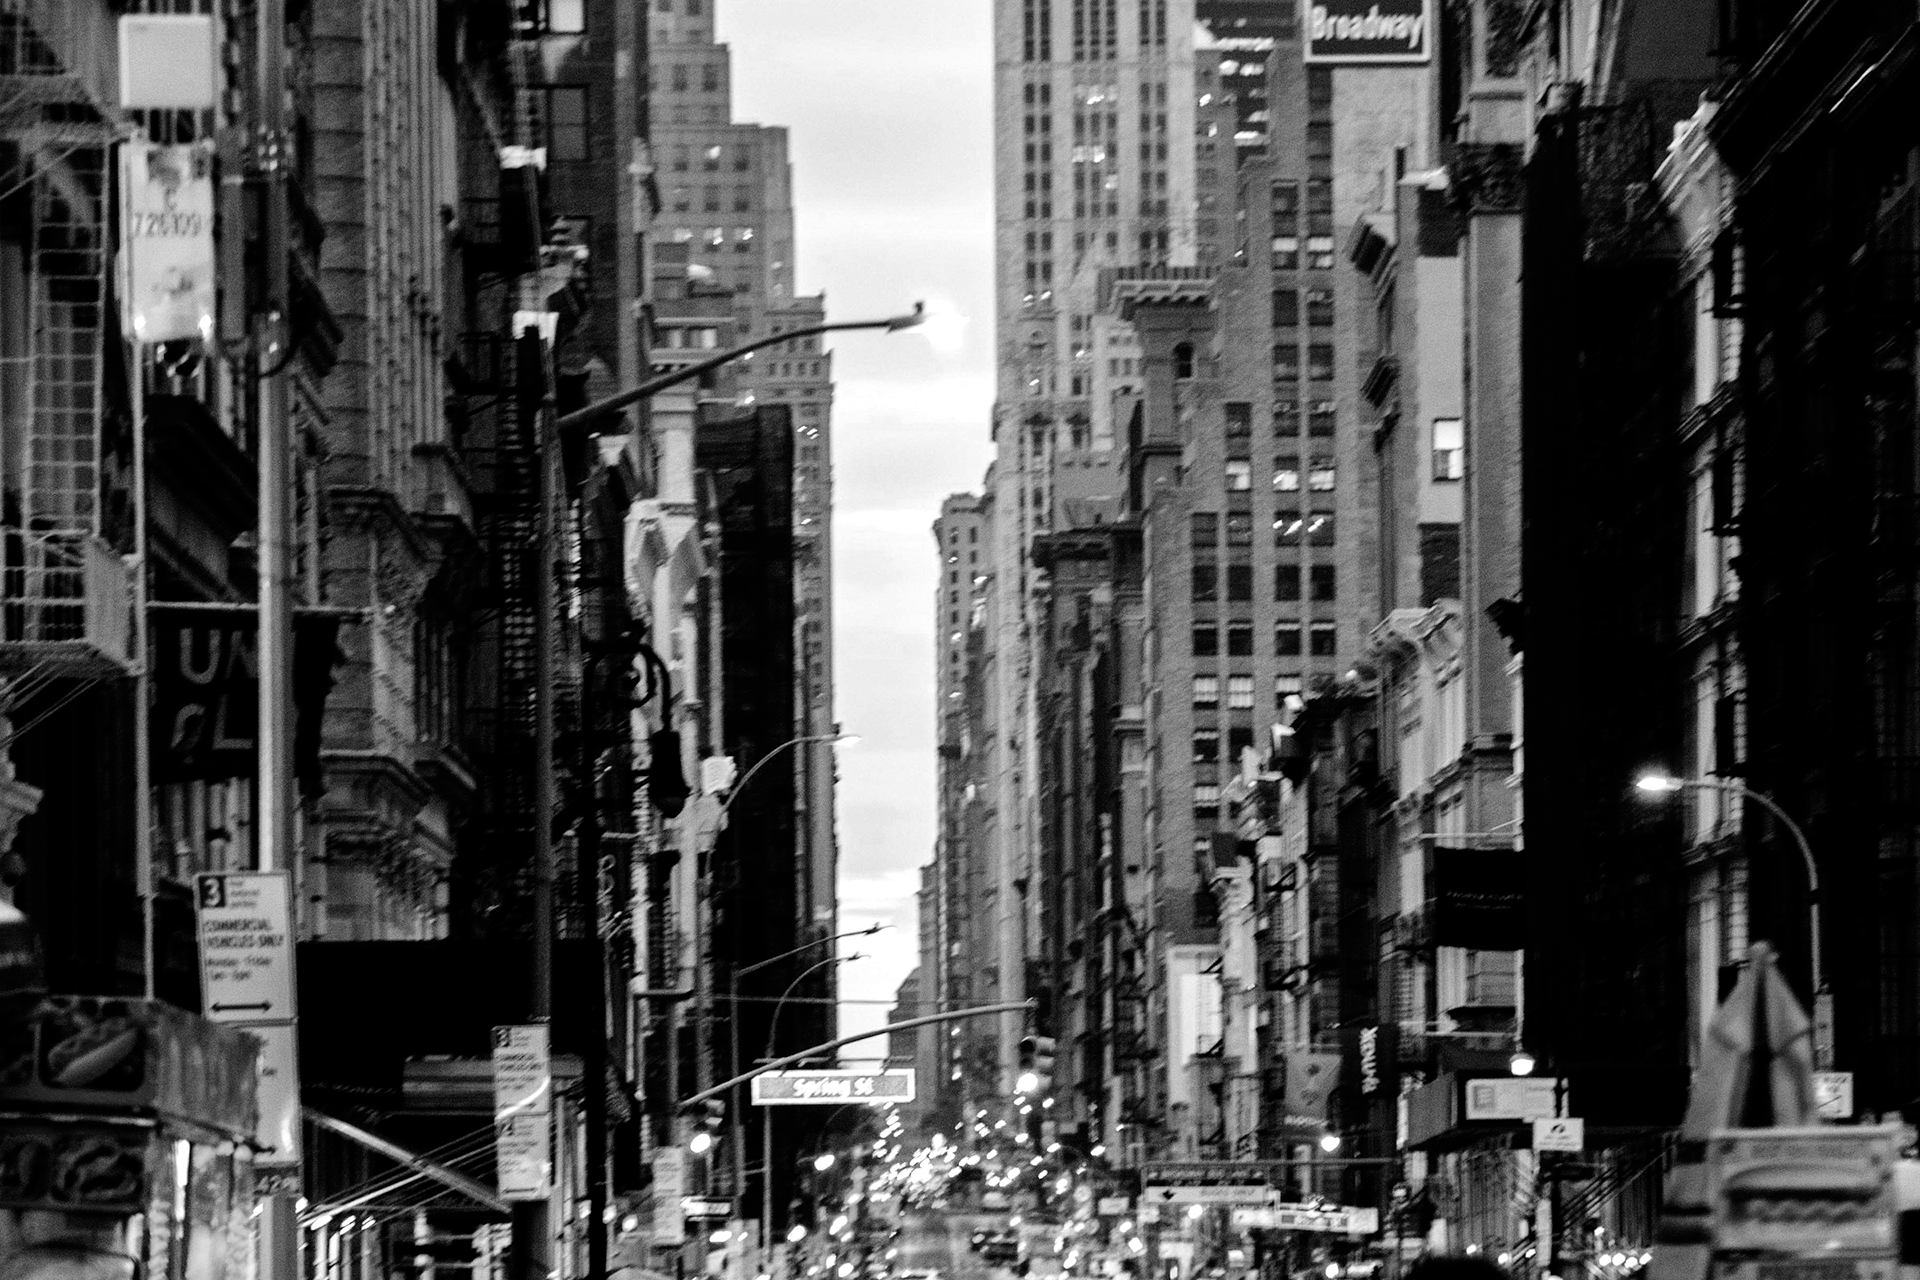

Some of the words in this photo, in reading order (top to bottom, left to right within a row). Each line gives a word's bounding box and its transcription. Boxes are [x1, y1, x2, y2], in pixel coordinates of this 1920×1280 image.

[1309, 4, 1422, 49] Broadway
[204, 878, 221, 906] 3
[793, 1077, 850, 1099] Spring
[853, 1077, 874, 1096] St
